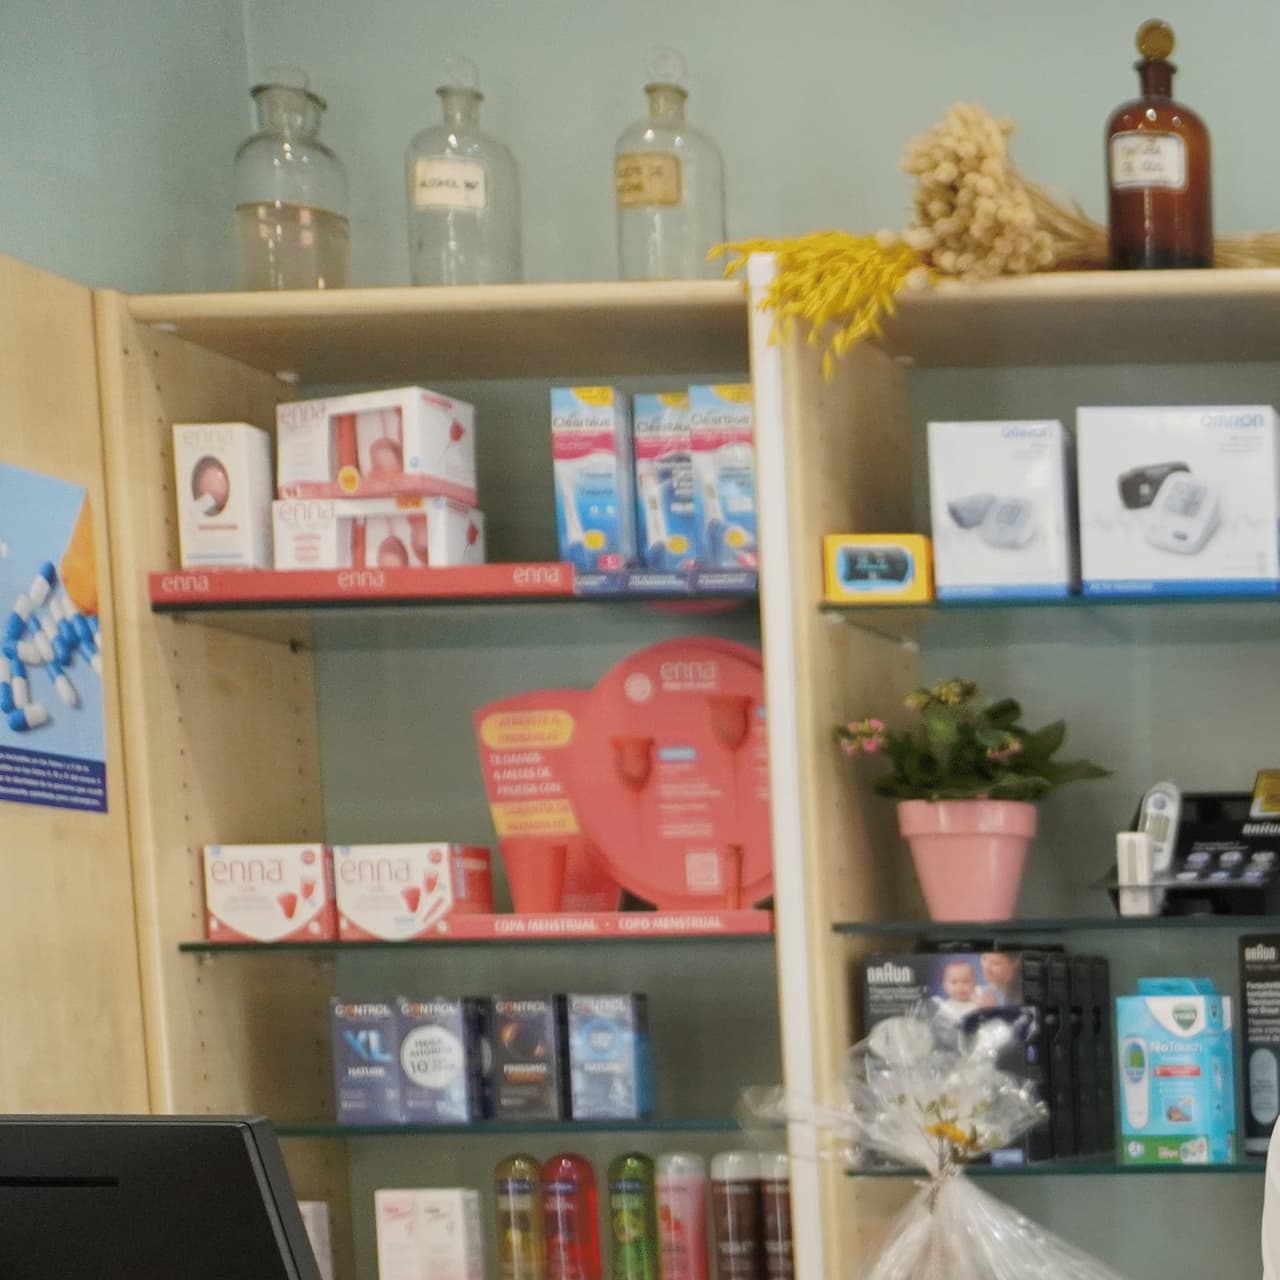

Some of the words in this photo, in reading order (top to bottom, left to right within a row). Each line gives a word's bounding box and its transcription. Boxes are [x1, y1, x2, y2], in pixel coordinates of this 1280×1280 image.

[280, 500, 336, 520] enna
[161, 574, 209, 593] enna
[337, 570, 386, 588] enna
[513, 567, 561, 584] enna
[659, 661, 718, 681] enna
[210, 858, 284, 884] enna
[338, 858, 412, 883] enna
[494, 918, 526, 932] COPA
[528, 917, 597, 932] MENSTRUAL
[653, 915, 722, 929] MENSTRUAL
[1244, 943, 1276, 961] BRAUN
[866, 961, 912, 985] BRAUN
[335, 1003, 391, 1018] CONTROL
[401, 1002, 456, 1017] CONTROL
[495, 1000, 548, 1015] CONTROL
